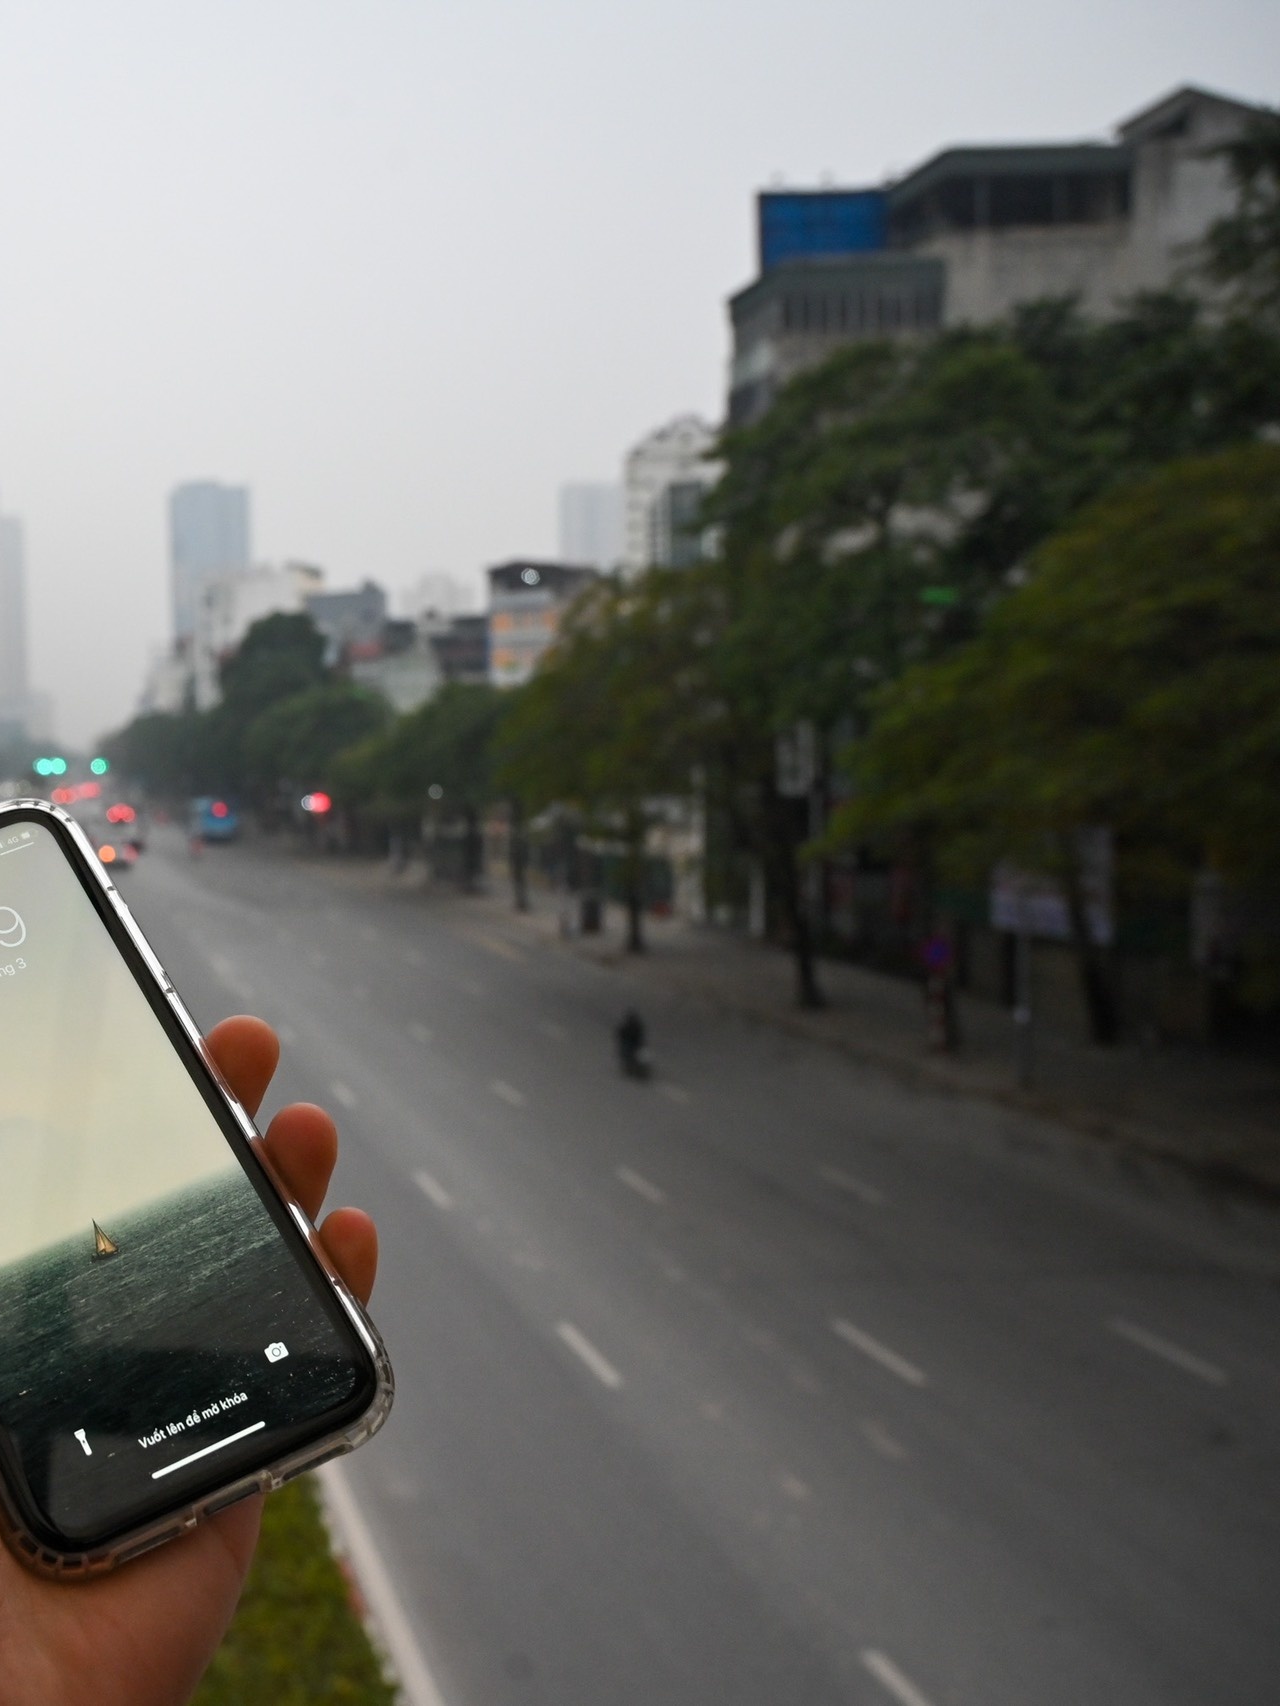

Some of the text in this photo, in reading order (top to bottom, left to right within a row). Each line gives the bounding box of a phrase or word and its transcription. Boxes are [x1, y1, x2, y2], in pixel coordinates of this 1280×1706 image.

[7, 836, 19, 845] 4G
[15, 957, 27, 970] 3
[137, 1427, 167, 1449] Vuốt
[165, 1422, 186, 1437] lên
[219, 1392, 248, 1411] khóa
